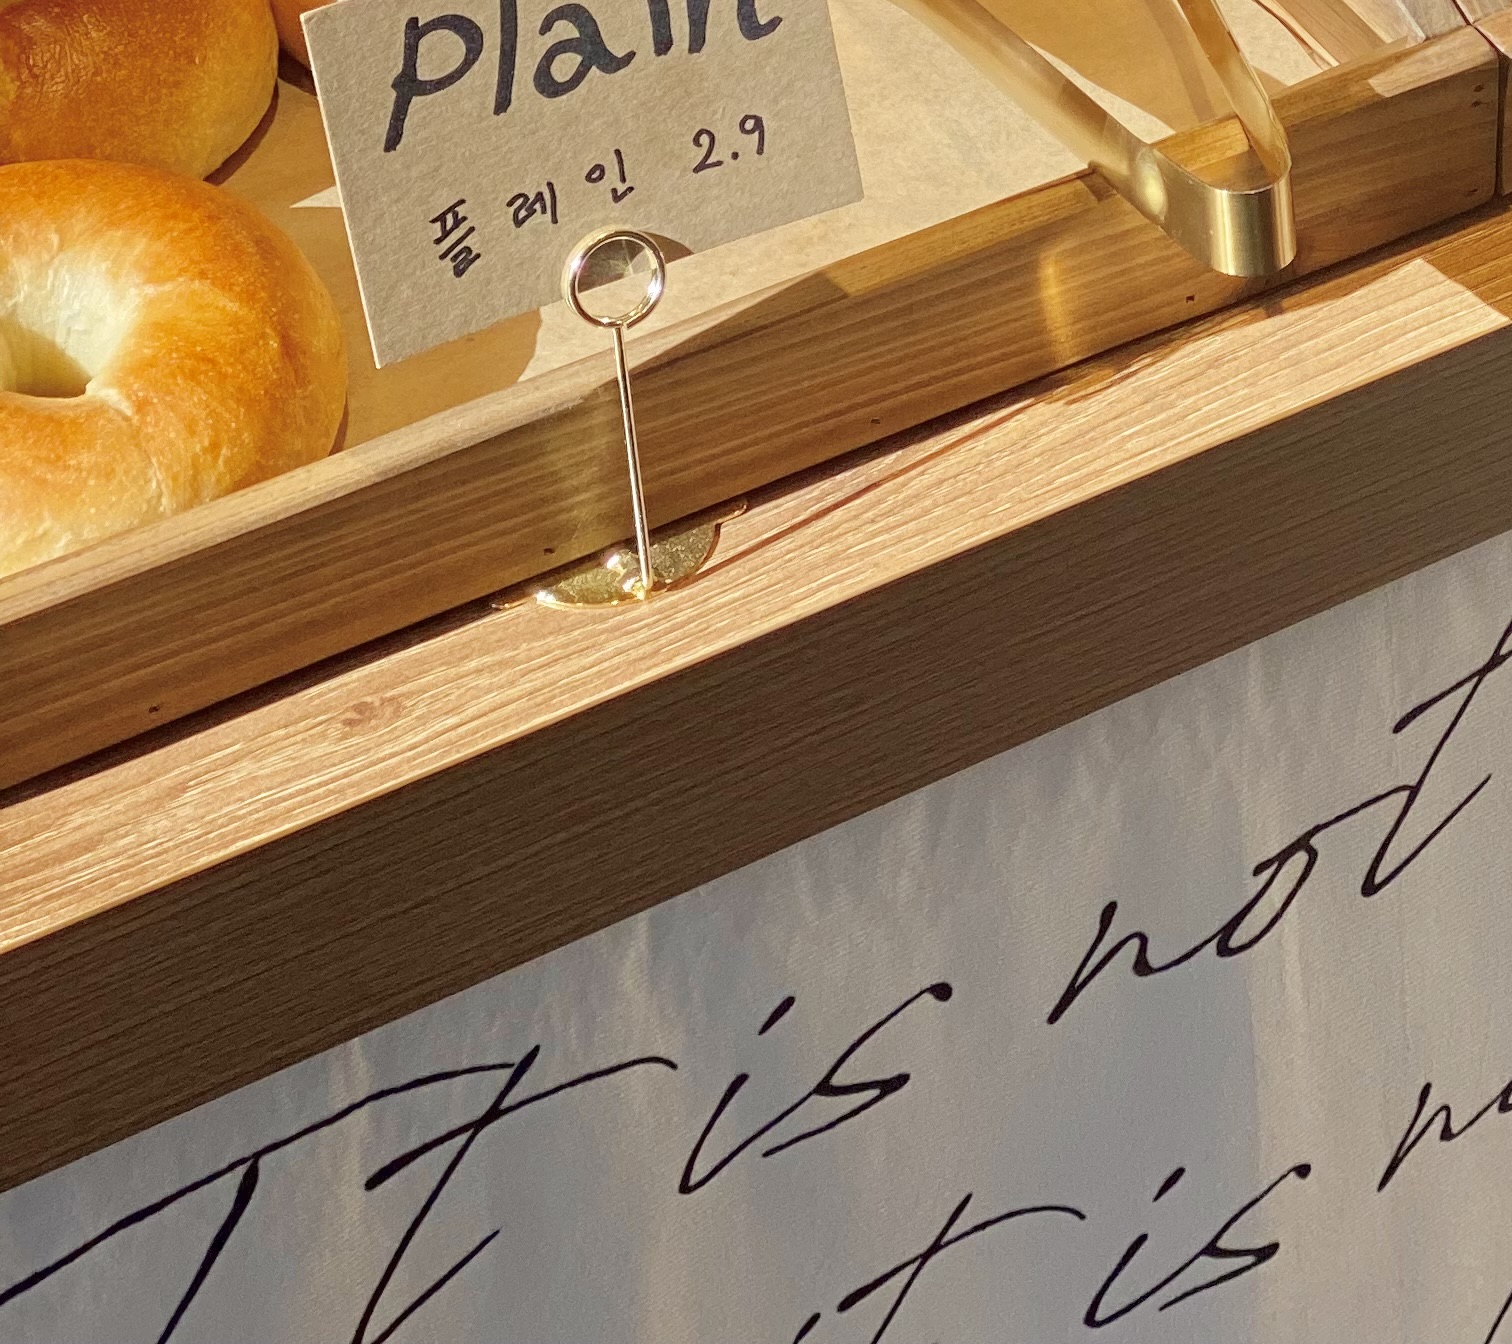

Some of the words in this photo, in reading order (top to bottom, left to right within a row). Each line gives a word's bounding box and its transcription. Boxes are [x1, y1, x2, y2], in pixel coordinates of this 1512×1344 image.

[691, 113, 766, 174] 2.9
[678, 981, 954, 1196] is
[1083, 1162, 1312, 1330] is
